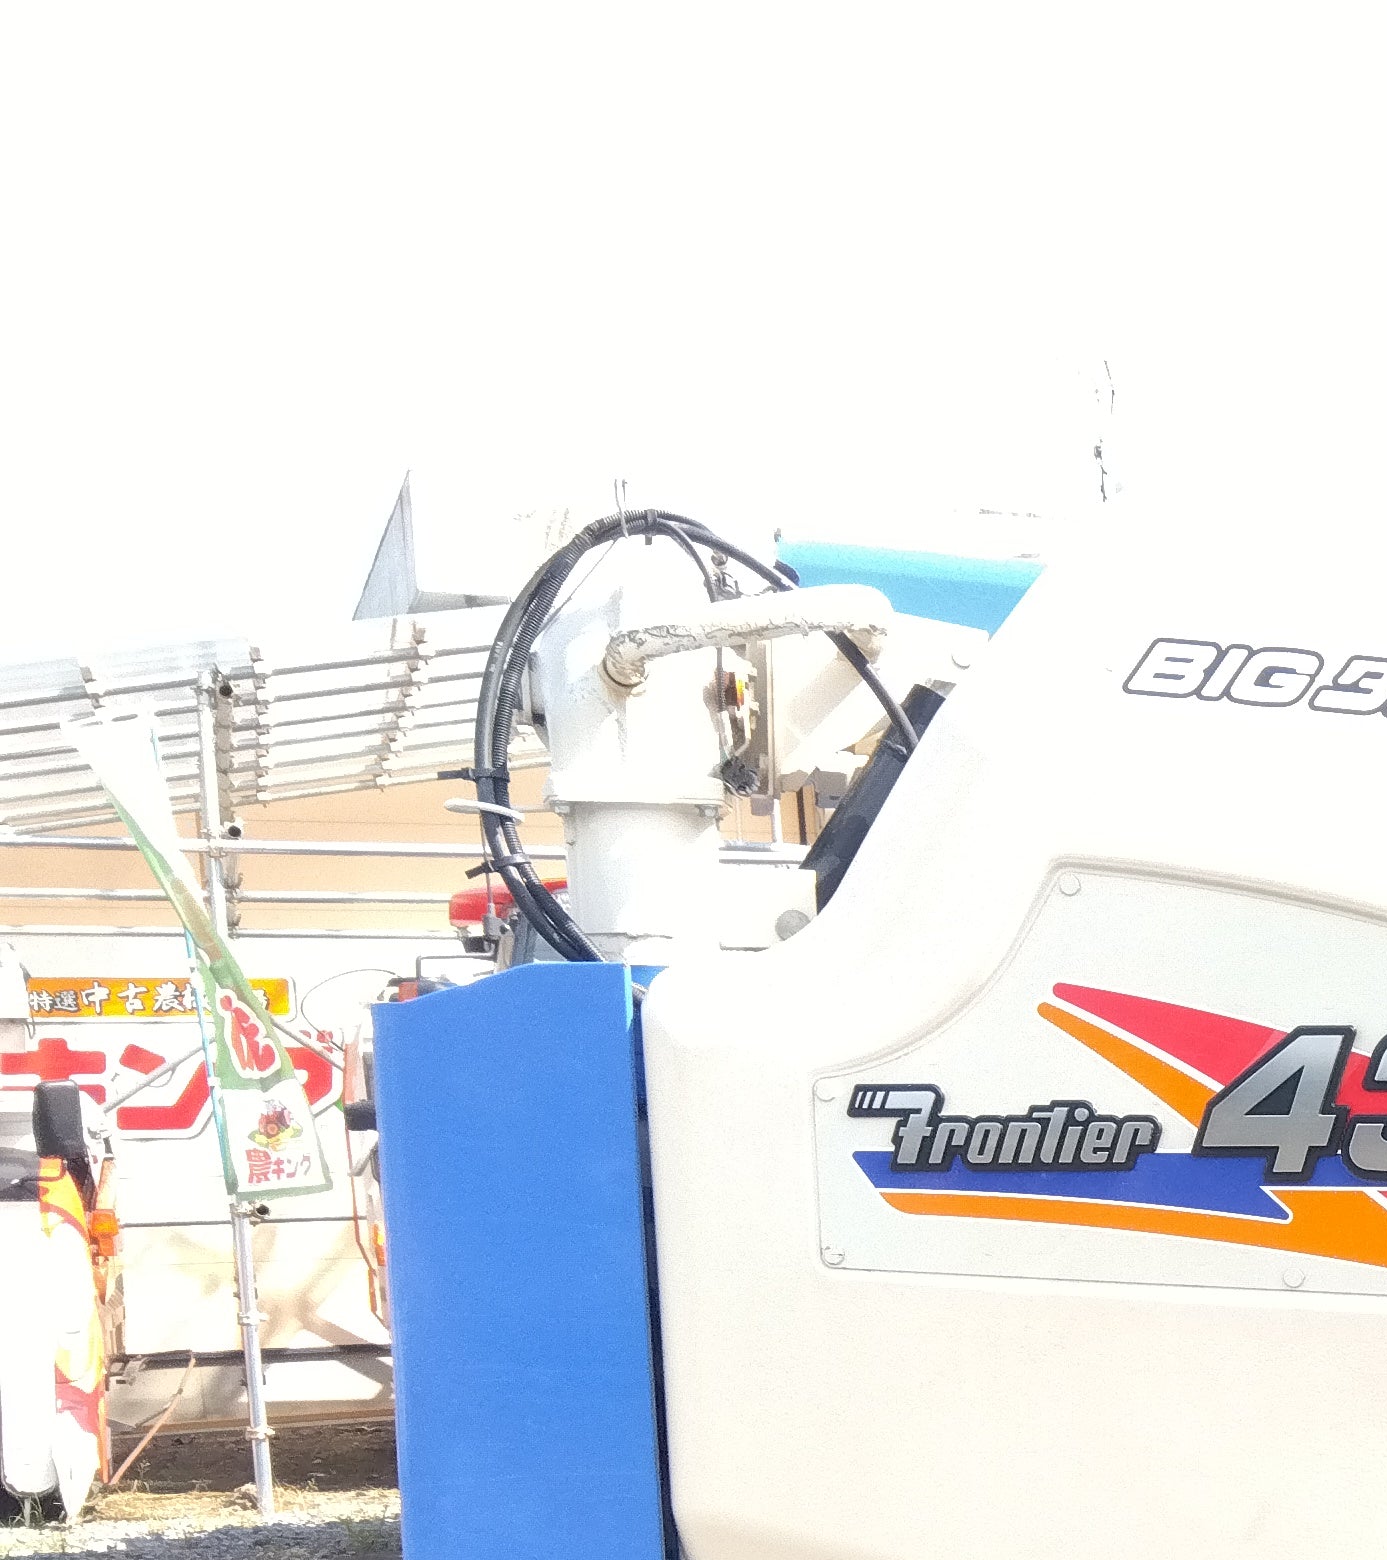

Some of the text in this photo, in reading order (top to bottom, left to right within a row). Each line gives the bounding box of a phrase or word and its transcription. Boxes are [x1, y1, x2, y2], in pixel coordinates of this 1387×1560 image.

[1123, 637, 1325, 707] BIG
[28, 981, 270, 1013] 特選中古農
[848, 1083, 1162, 1171] Frontier
[246, 1147, 313, 1184] 農キング
